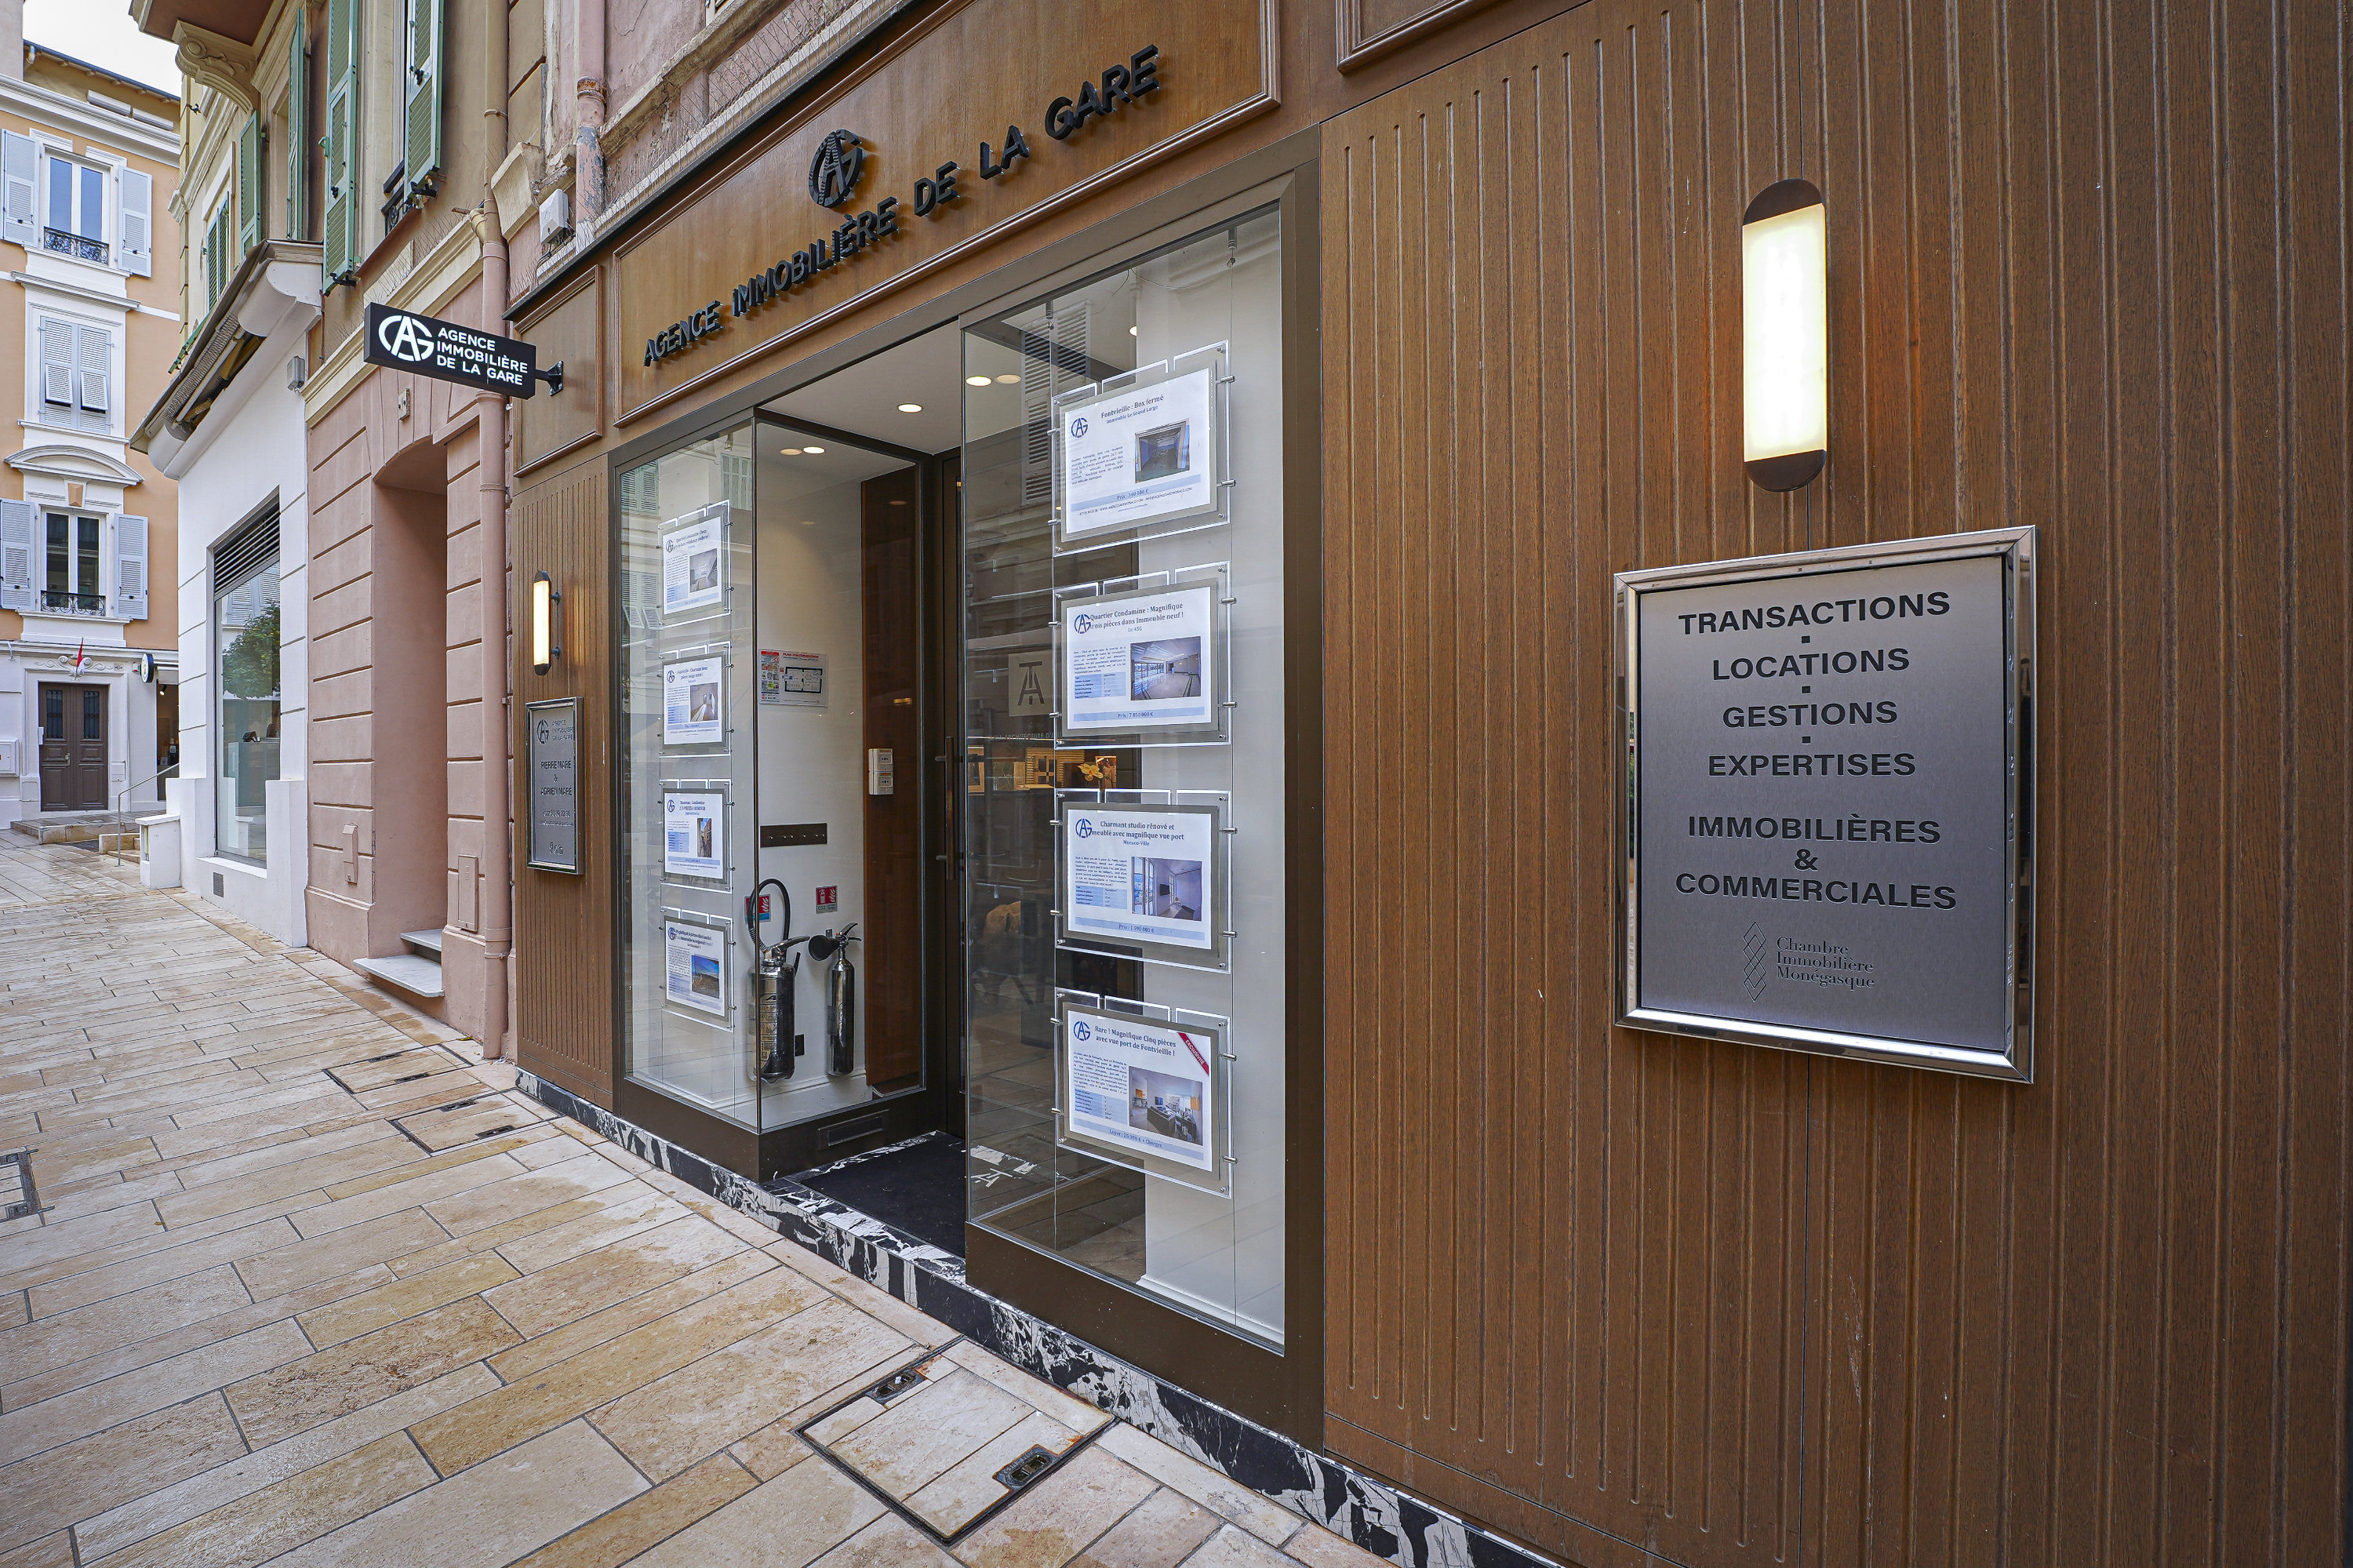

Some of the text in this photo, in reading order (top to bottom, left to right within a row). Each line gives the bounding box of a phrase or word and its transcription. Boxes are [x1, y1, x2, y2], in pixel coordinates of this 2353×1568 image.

[643, 44, 1161, 367] AGENCE IMMOBILIÈRE DE LA GARE
[438, 327, 496, 351] AGENCE
[437, 341, 528, 373] IMMOBILIÈRE
[437, 355, 523, 385] DE LA GARE
[1101, 405, 1130, 418] Fontvieille
[1146, 394, 1164, 405] fermé
[1090, 610, 1114, 621] Quartier
[1114, 607, 1146, 618] Condamine
[1150, 602, 1183, 613] Magnifique
[1104, 619, 1121, 629] pièces
[1122, 617, 1135, 626] dans
[1136, 613, 1166, 624] Immeuble
[1166, 612, 1180, 621] neuf
[1678, 591, 1951, 635] TRANSACTIONS
[1713, 648, 1910, 681] LOCATIONS
[1722, 700, 1898, 729] GESTIONS
[540, 758, 572, 769] PIERRE MARÉ
[1708, 752, 1916, 777] EXPERTISES
[553, 773, 558, 783] &
[540, 785, 573, 796] ADRIEN MARÉ
[1092, 828, 1112, 836] meublé
[1126, 831, 1158, 840] magnifique
[1147, 821, 1168, 830] rénové
[1688, 813, 1941, 844] IMMOBILIÈRES
[1794, 849, 1819, 872] &
[1675, 873, 1957, 911] COMMERCIALES
[1776, 937, 1849, 957] Chambre
[1776, 950, 1874, 973] Immobilière
[1776, 966, 1875, 991] Monégasque
[1095, 1025, 1107, 1034] Rare
[1111, 1028, 1143, 1041] Magnifique
[1144, 1035, 1156, 1046] Cinq
[1158, 1037, 1176, 1048] pièces
[1140, 1043, 1172, 1056] Fontvieille
[1145, 1139, 1162, 1148] Charges
